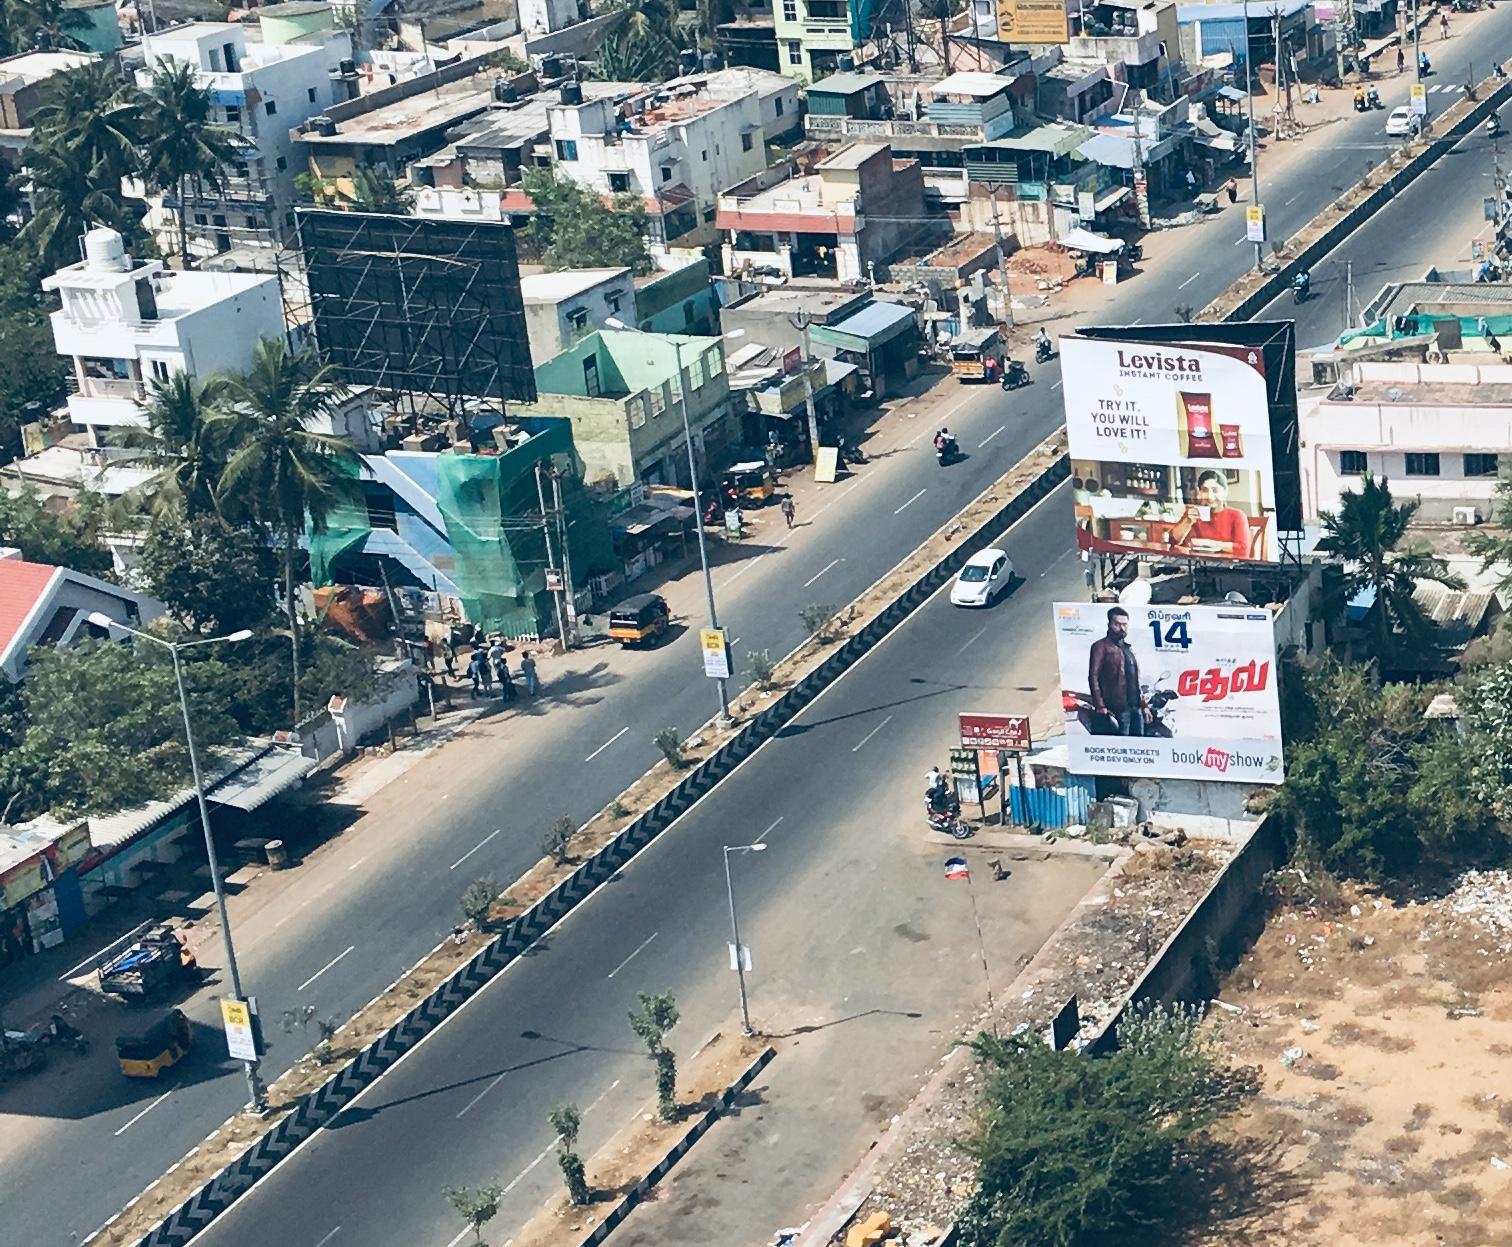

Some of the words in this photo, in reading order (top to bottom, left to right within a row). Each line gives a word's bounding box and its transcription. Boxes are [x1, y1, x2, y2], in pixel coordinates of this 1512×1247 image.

[1117, 350, 1201, 372] Levista
[1119, 370, 1161, 380] INSTANT
[1165, 373, 1203, 382] COFFEE
[1098, 399, 1122, 411] TRY
[1091, 412, 1116, 425] YOU
[1119, 415, 1150, 427] WILL
[1096, 426, 1127, 438] LOVE
[1130, 428, 1147, 440] IT!
[1148, 620, 1192, 649] 14
[1084, 746, 1106, 754] BOOK
[1107, 747, 1128, 755] YOUR
[1129, 748, 1160, 757] TICKETS
[1106, 755, 1122, 763] DEV
[1122, 756, 1142, 764] ONLY
